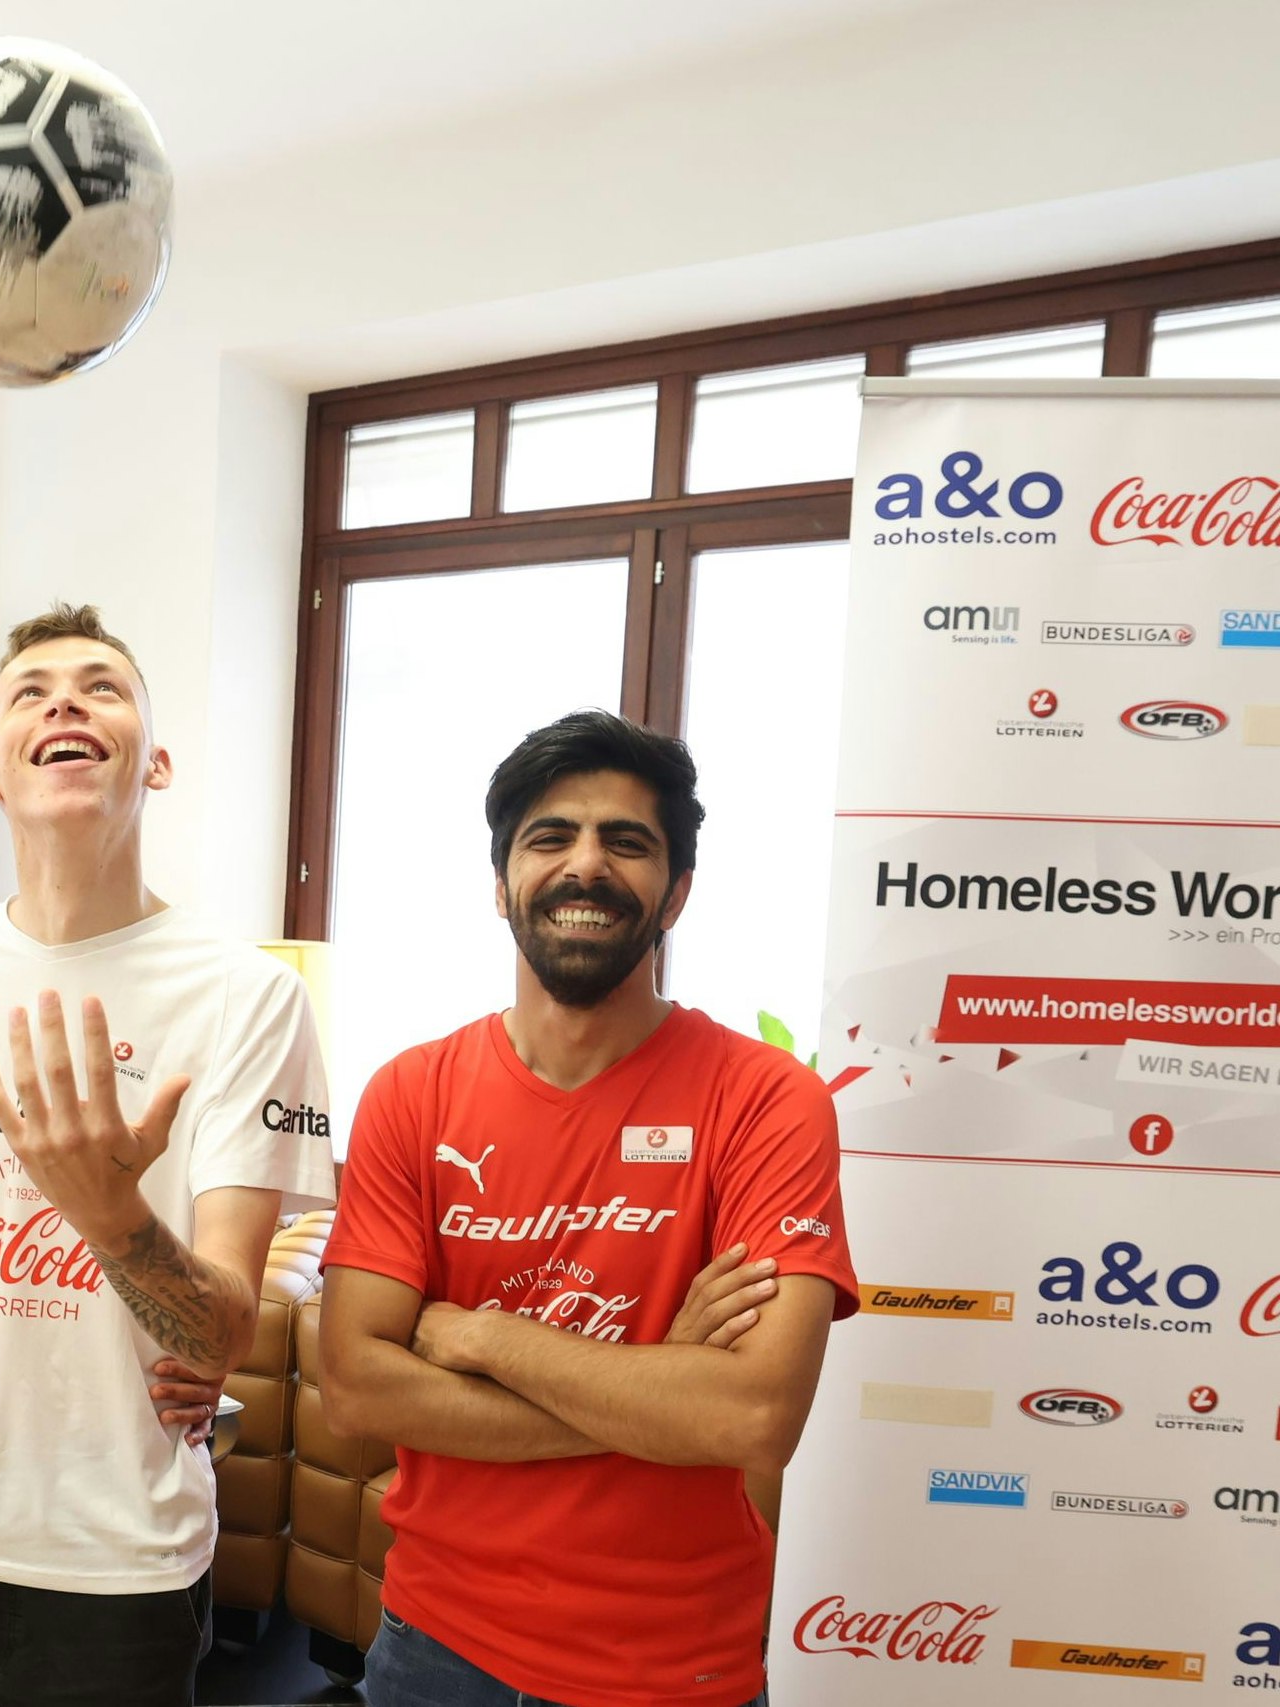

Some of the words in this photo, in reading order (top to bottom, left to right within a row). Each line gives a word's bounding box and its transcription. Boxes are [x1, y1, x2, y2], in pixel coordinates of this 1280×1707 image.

[875, 451, 1063, 520] a&o
[874, 527, 1056, 546] aohostels.com
[952, 635, 989, 645] Sensing
[991, 636, 999, 644] is
[1046, 625, 1171, 643] BUNDESLIGA
[996, 727, 1084, 738] LOTTERIEN
[876, 861, 1156, 917] Homeless
[1216, 926, 1244, 944] ein
[1137, 1053, 1183, 1076] WIR
[1189, 1059, 1270, 1084] SAGEN
[16, 1188, 42, 1201] 1929
[1037, 1241, 1221, 1310] a&o
[871, 1290, 978, 1312] Gaulhofer
[1036, 1310, 1213, 1334] aohostels.com
[1155, 1420, 1244, 1433] LOTTERIEN
[931, 1471, 1025, 1493] SANDVIK
[1056, 1495, 1168, 1515] BUNDESLIGA
[1240, 1514, 1277, 1526] Sensing
[793, 1595, 1001, 1665] Coca-Cola
[1060, 1647, 1169, 1671] Gaulhofer
